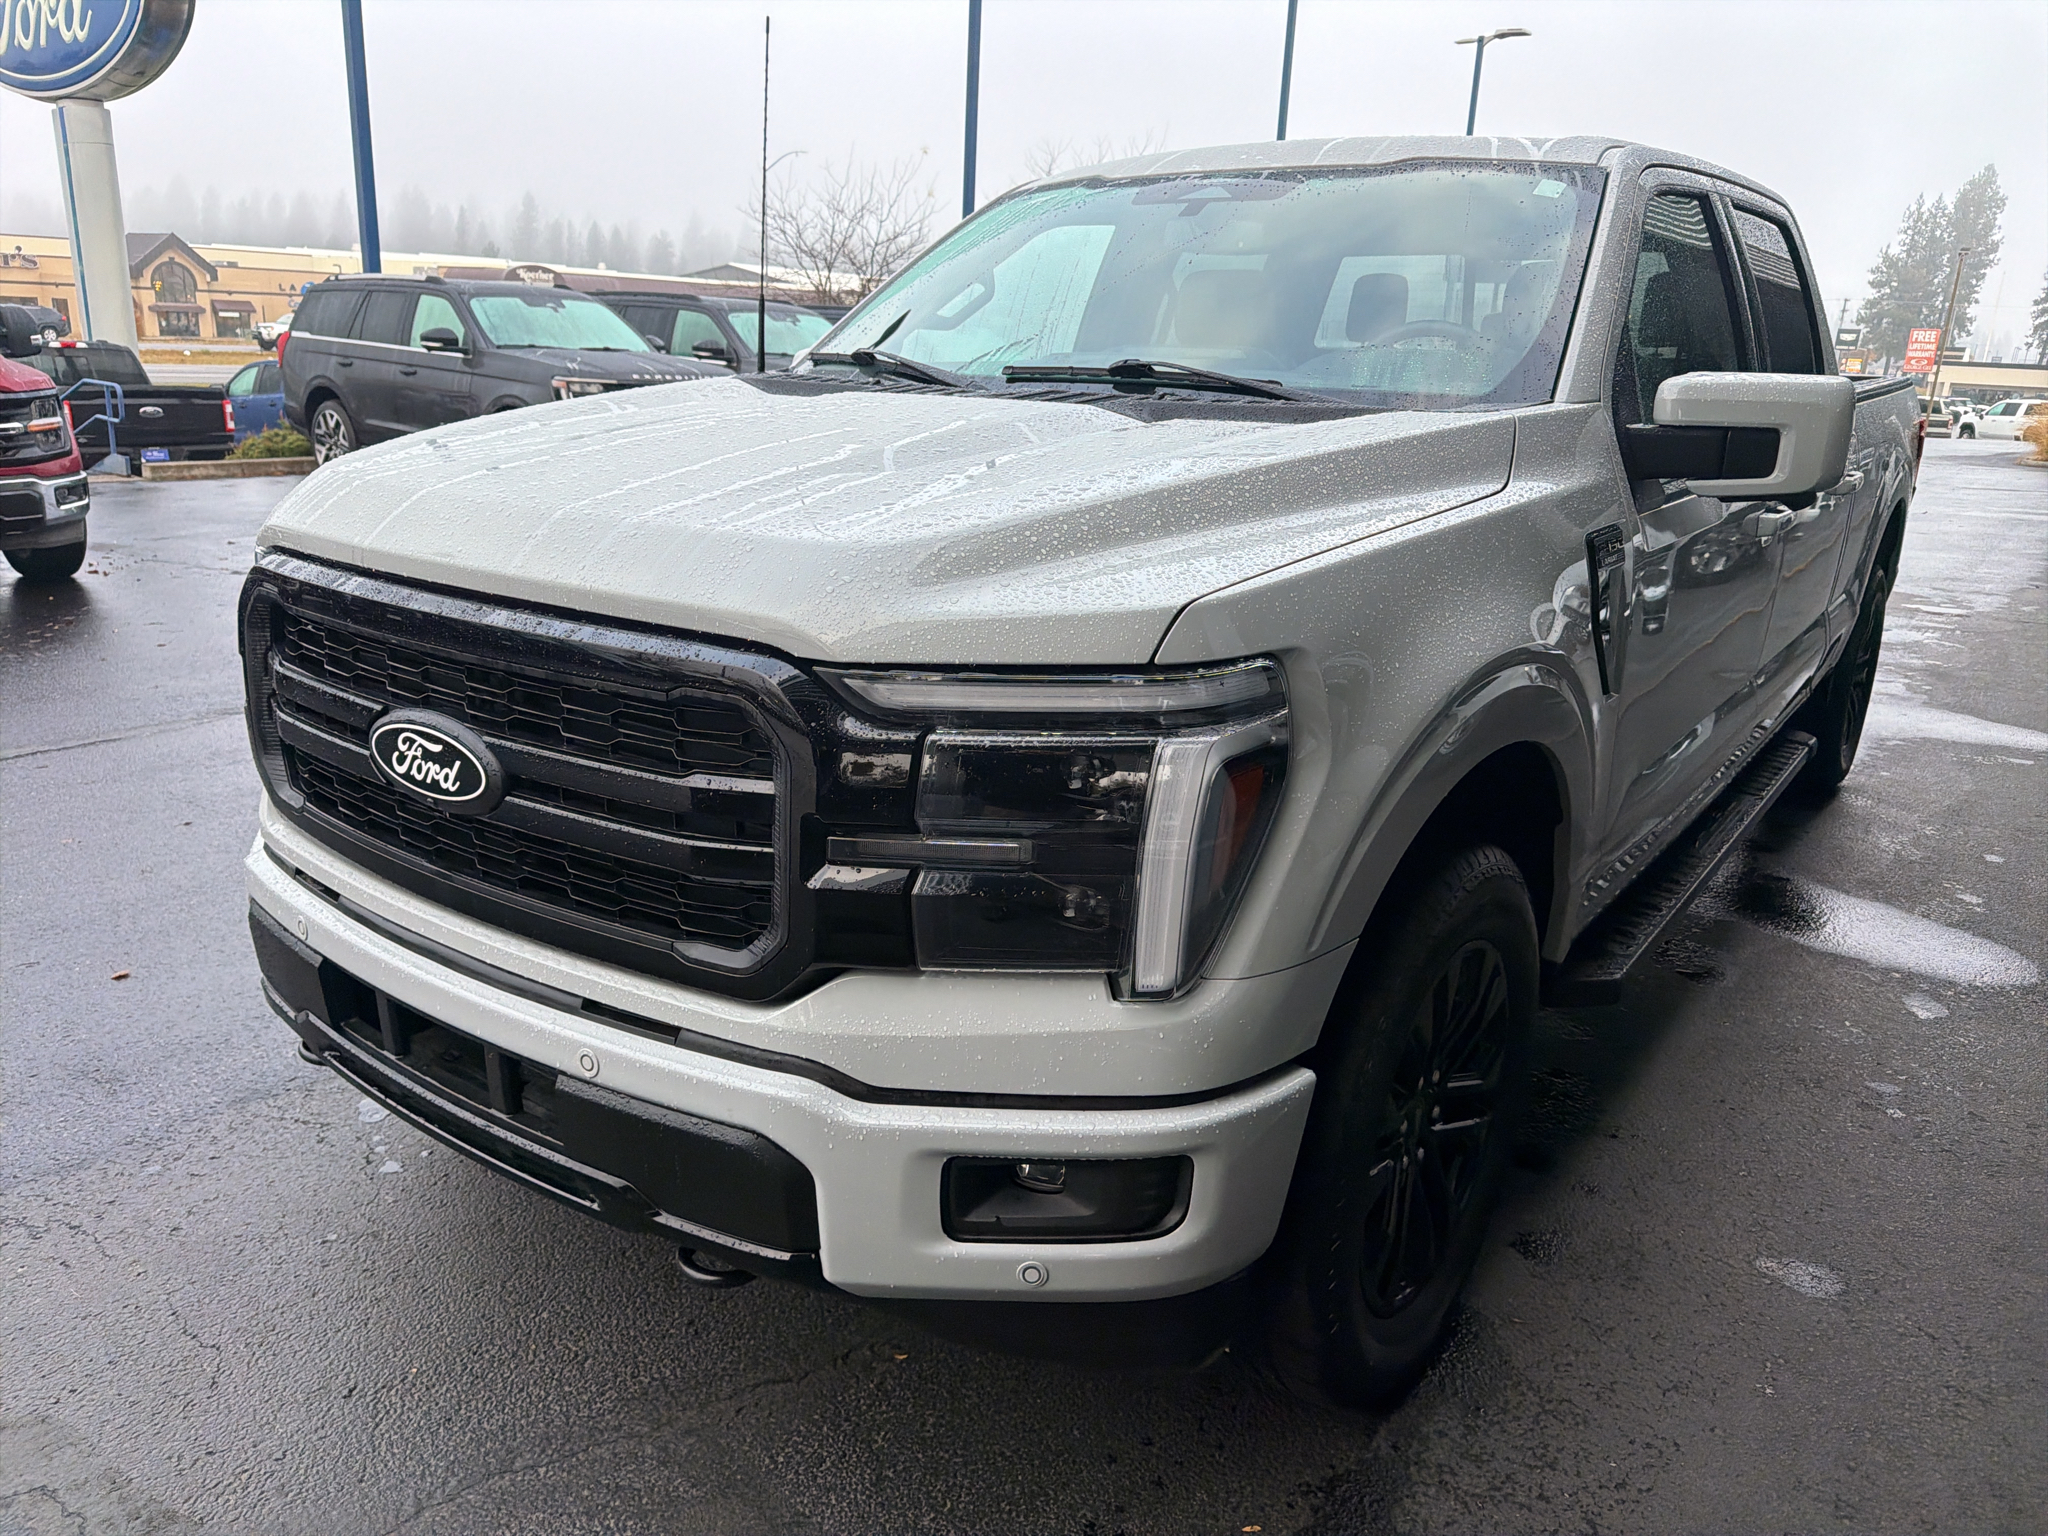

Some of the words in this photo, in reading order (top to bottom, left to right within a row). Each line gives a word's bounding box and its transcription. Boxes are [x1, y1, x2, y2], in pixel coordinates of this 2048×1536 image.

[0, 0, 93, 54] ord
[0, 245, 38, 268] r's
[1912, 330, 1937, 342] FREE
[1907, 350, 1935, 358] WARRANTY
[392, 731, 462, 792] Ford
